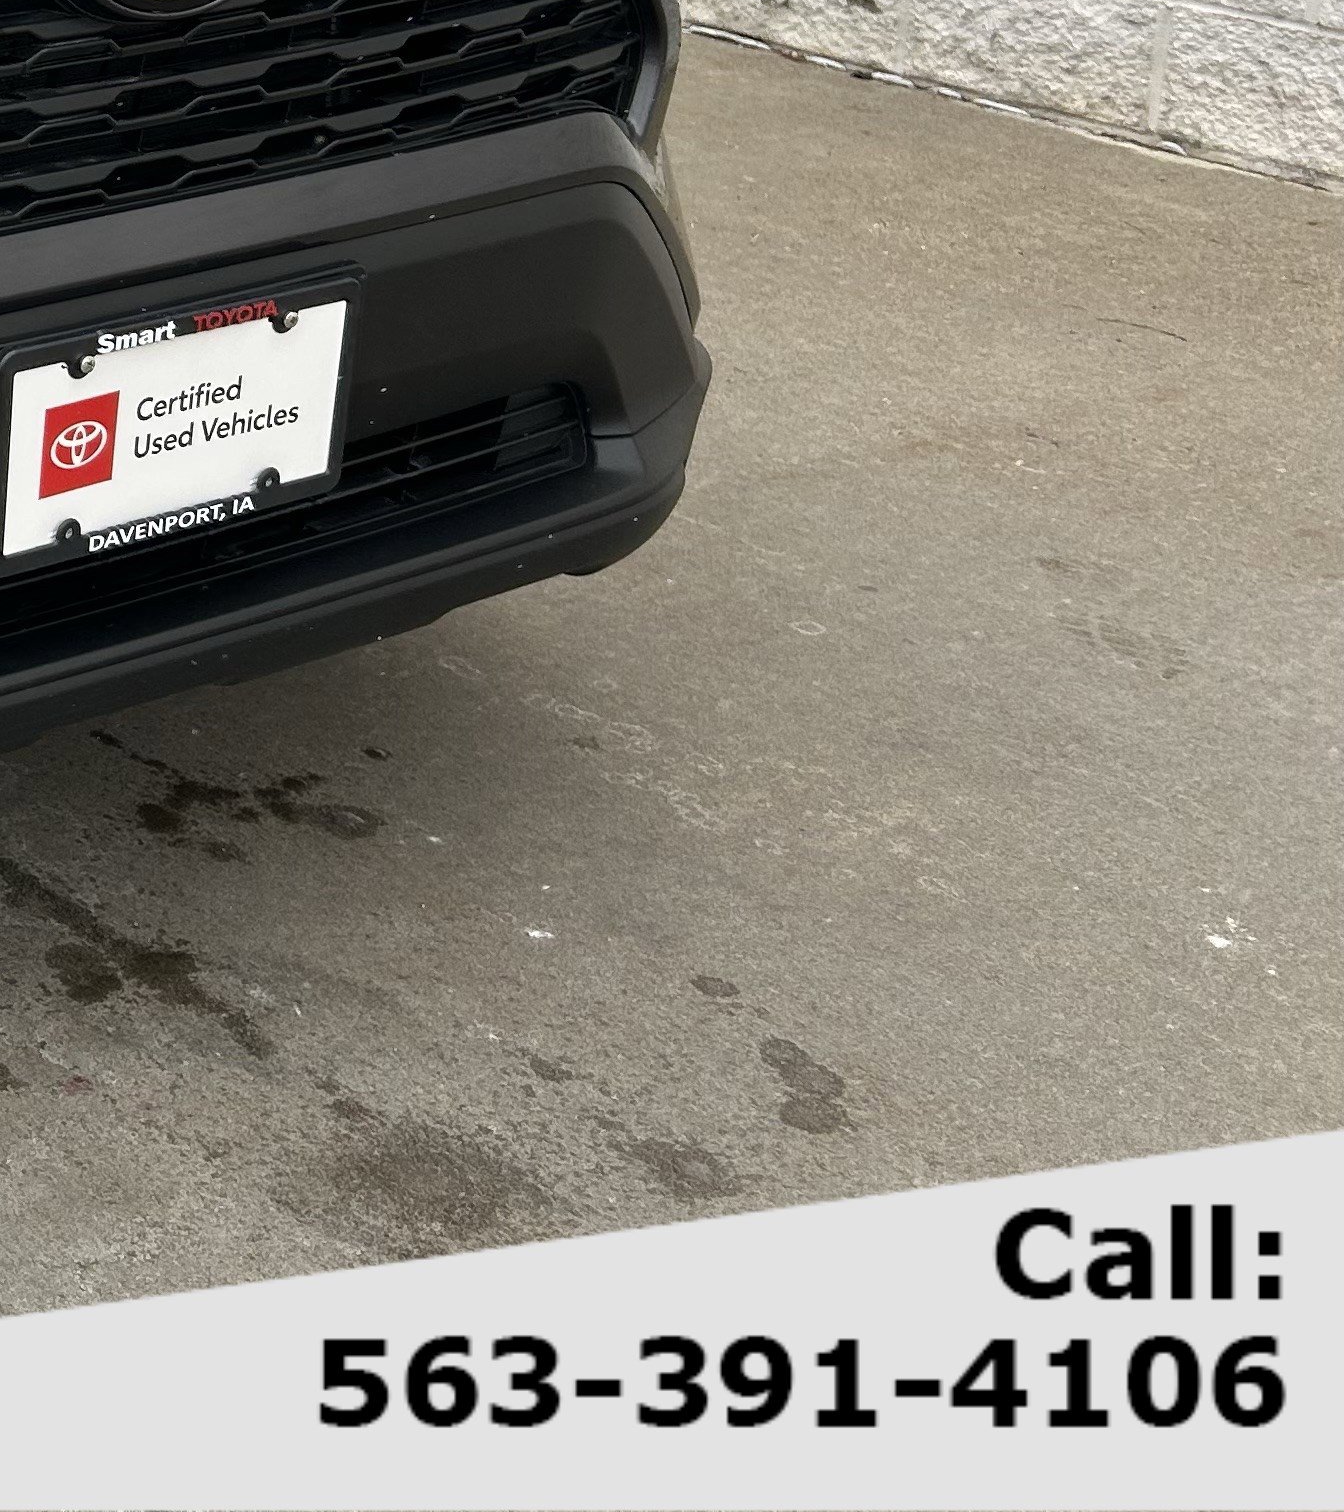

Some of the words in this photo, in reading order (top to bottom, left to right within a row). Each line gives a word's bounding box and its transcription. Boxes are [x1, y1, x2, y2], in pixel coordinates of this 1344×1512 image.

[97, 320, 177, 355] Smart
[193, 300, 279, 332] TOYOTA
[136, 375, 243, 422] Certified
[133, 420, 194, 458] Used
[201, 403, 300, 442] Vehicles
[88, 502, 228, 553] DAVENPORT,
[232, 496, 255, 516] IA
